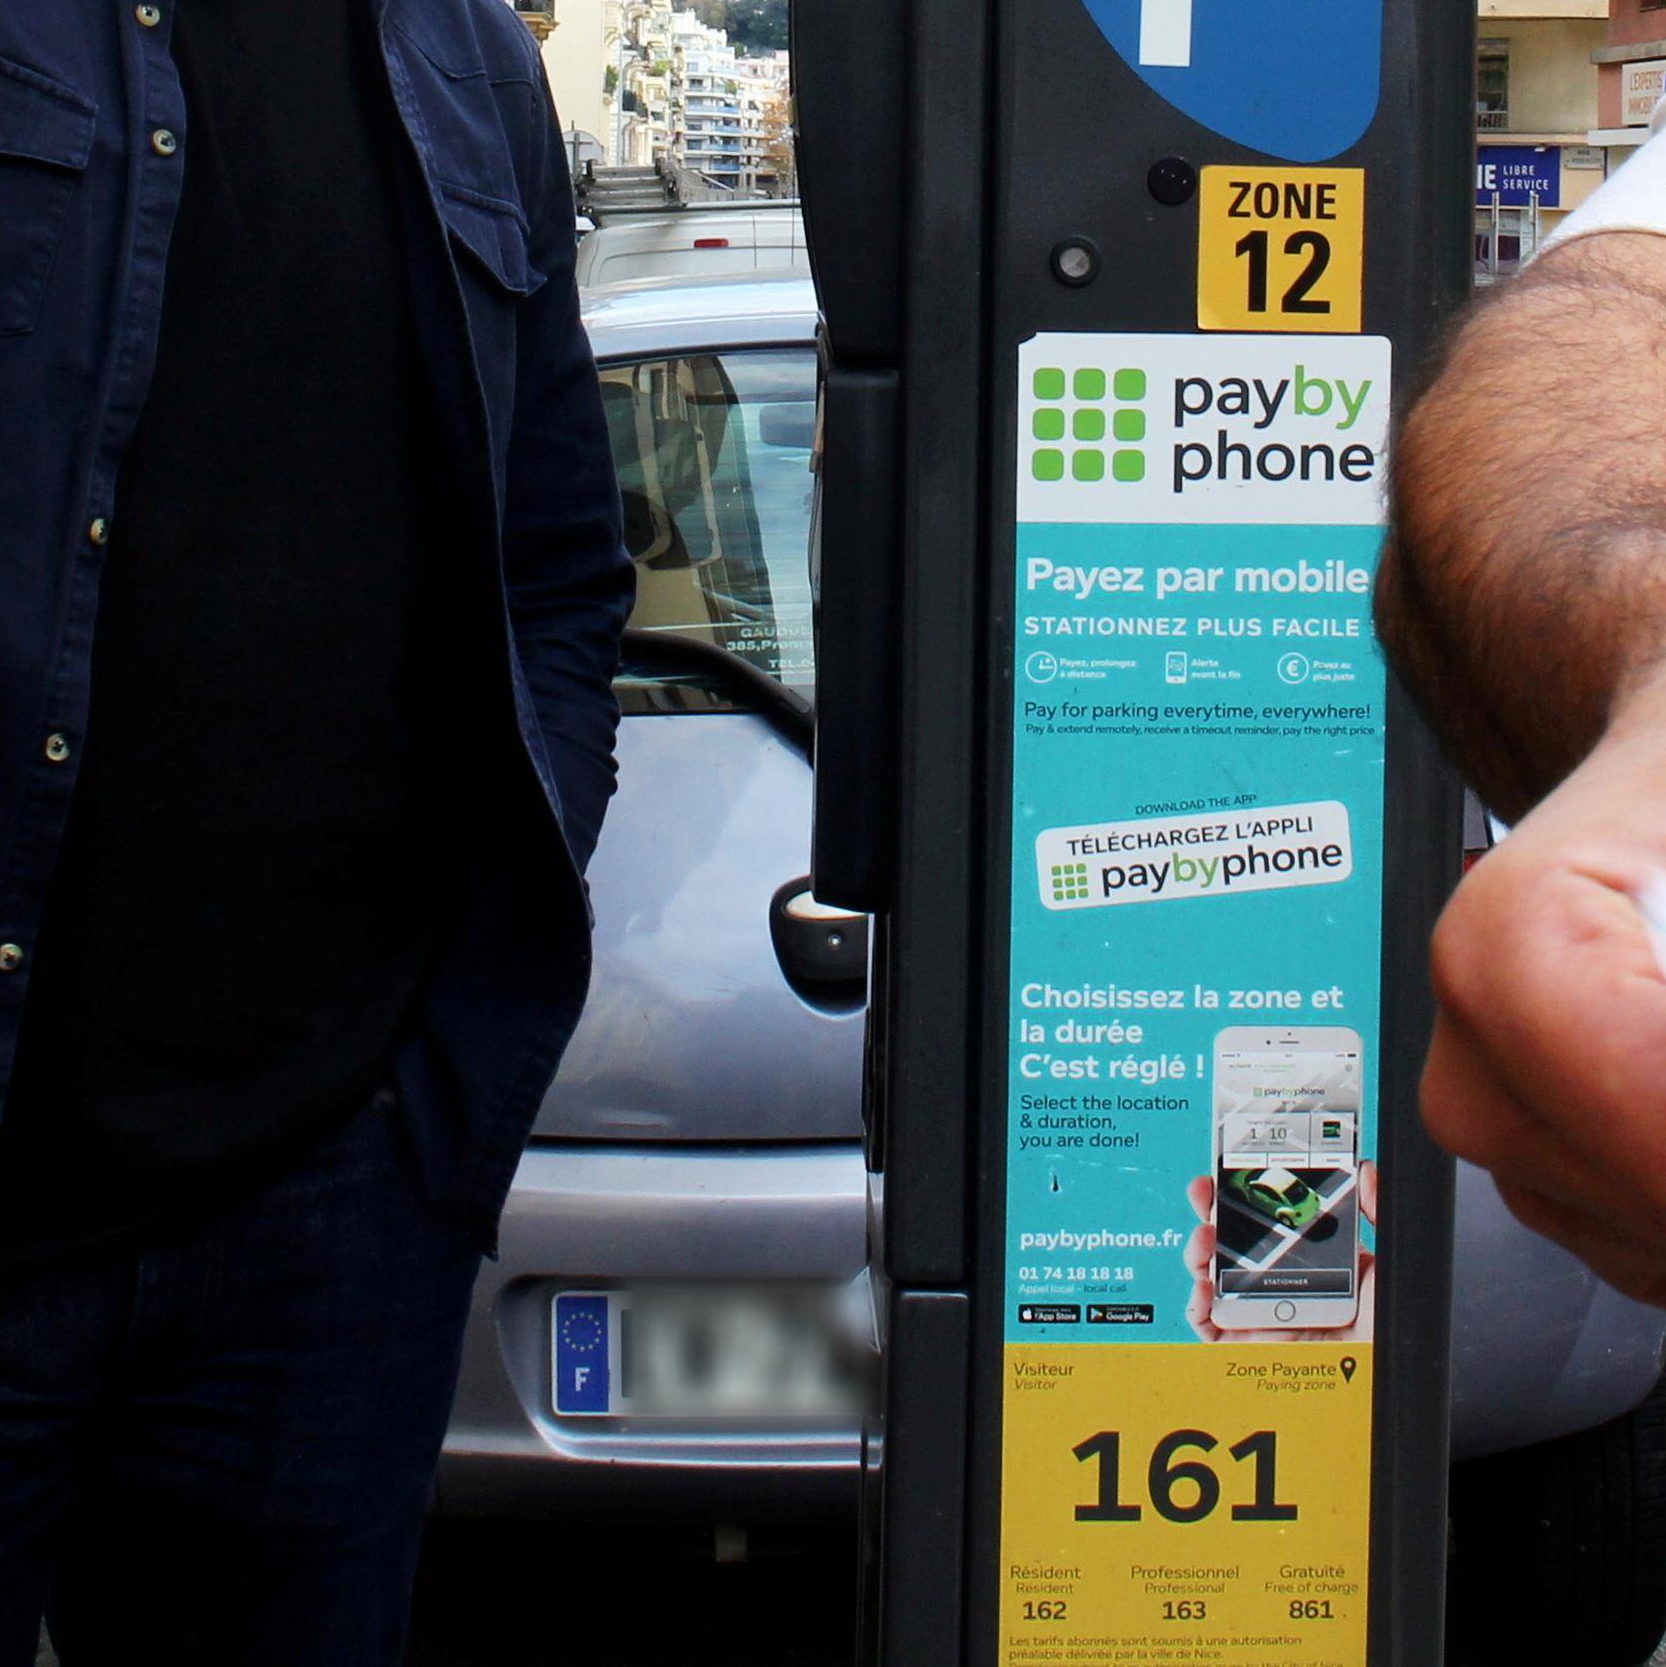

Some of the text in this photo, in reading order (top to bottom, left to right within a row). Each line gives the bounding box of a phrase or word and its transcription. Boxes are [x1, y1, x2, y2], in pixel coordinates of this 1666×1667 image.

[1503, 164, 1535, 176] LIBRE
[1503, 178, 1549, 191] SERVICE
[1227, 181, 1338, 222] ZONE
[1234, 229, 1333, 316] 12
[1173, 364, 1373, 430] payby
[1172, 428, 1375, 493] phone
[1026, 557, 1369, 600] Payez par mobile
[1024, 616, 1187, 636] STATIONNEZ
[1197, 617, 1263, 637] PLUS
[1273, 618, 1361, 638] FACILE
[1024, 701, 1371, 723] Pay for parking everytime, everywhere!
[1025, 723, 1046, 736] Pay
[1056, 723, 1094, 735] extend
[1094, 724, 1144, 736] remotely,
[1144, 725, 1181, 736] receive
[1182, 727, 1190, 735] a
[1191, 724, 1232, 736] timeout
[1234, 724, 1282, 737] reminder,
[1282, 727, 1303, 738] pay
[1303, 725, 1322, 736] the
[1322, 725, 1348, 739] right
[1349, 726, 1376, 739] price
[1135, 793, 1258, 816] DOWNLOAD THE APP
[1066, 816, 1315, 857] TÉLÉCHARGEZ L'APPLI
[1101, 842, 1344, 898] paybyphone
[1021, 982, 1344, 1010] Choisissez la zone et
[1020, 1018, 1144, 1045] la durée
[1019, 1053, 1205, 1086] C'est réglé !
[1020, 1094, 1190, 1111] Select the location
[1019, 1114, 1118, 1131] & duration,
[1019, 1132, 1140, 1151] you are done!
[1020, 1228, 1183, 1251] paybyphone.fr
[1018, 1266, 1134, 1280] 01 74 18 18 18
[1262, 1276, 1309, 1286] STATIONNER
[1019, 1283, 1128, 1295] Appel local local call
[1056, 1312, 1077, 1322] Store
[1106, 1312, 1134, 1324] Google
[1013, 1362, 1075, 1377] Visiteur
[1225, 1362, 1337, 1379] Zone Payante
[574, 1367, 591, 1393] F
[1014, 1378, 1058, 1390] Visitor
[1256, 1378, 1337, 1393] Paying zone
[1071, 1428, 1299, 1524] 161
[1009, 1564, 1081, 1580] Résident
[1130, 1564, 1240, 1580] Professionnel
[1279, 1563, 1346, 1579] Gratuité
[1016, 1582, 1075, 1595] Resident
[1144, 1581, 1226, 1595] Professional
[1264, 1581, 1360, 1596] Free of charge
[1021, 1601, 1068, 1621] 162
[1161, 1600, 1207, 1621] 163
[1288, 1599, 1335, 1620] 861
[1009, 1635, 1030, 1647] Les
[1032, 1635, 1065, 1647] tarifs
[1066, 1635, 1118, 1647] abonnés
[1120, 1636, 1148, 1647] sont
[1150, 1635, 1193, 1647] soumis
[1205, 1637, 1228, 1647] une
[1230, 1635, 1303, 1647] autorisation
[1008, 1648, 1063, 1661] préalable
[1065, 1648, 1113, 1660] délivrée
[1114, 1651, 1136, 1662] par
[1137, 1648, 1148, 1660] la
[1149, 1648, 1175, 1660] ville
[1176, 1648, 1193, 1660] de
